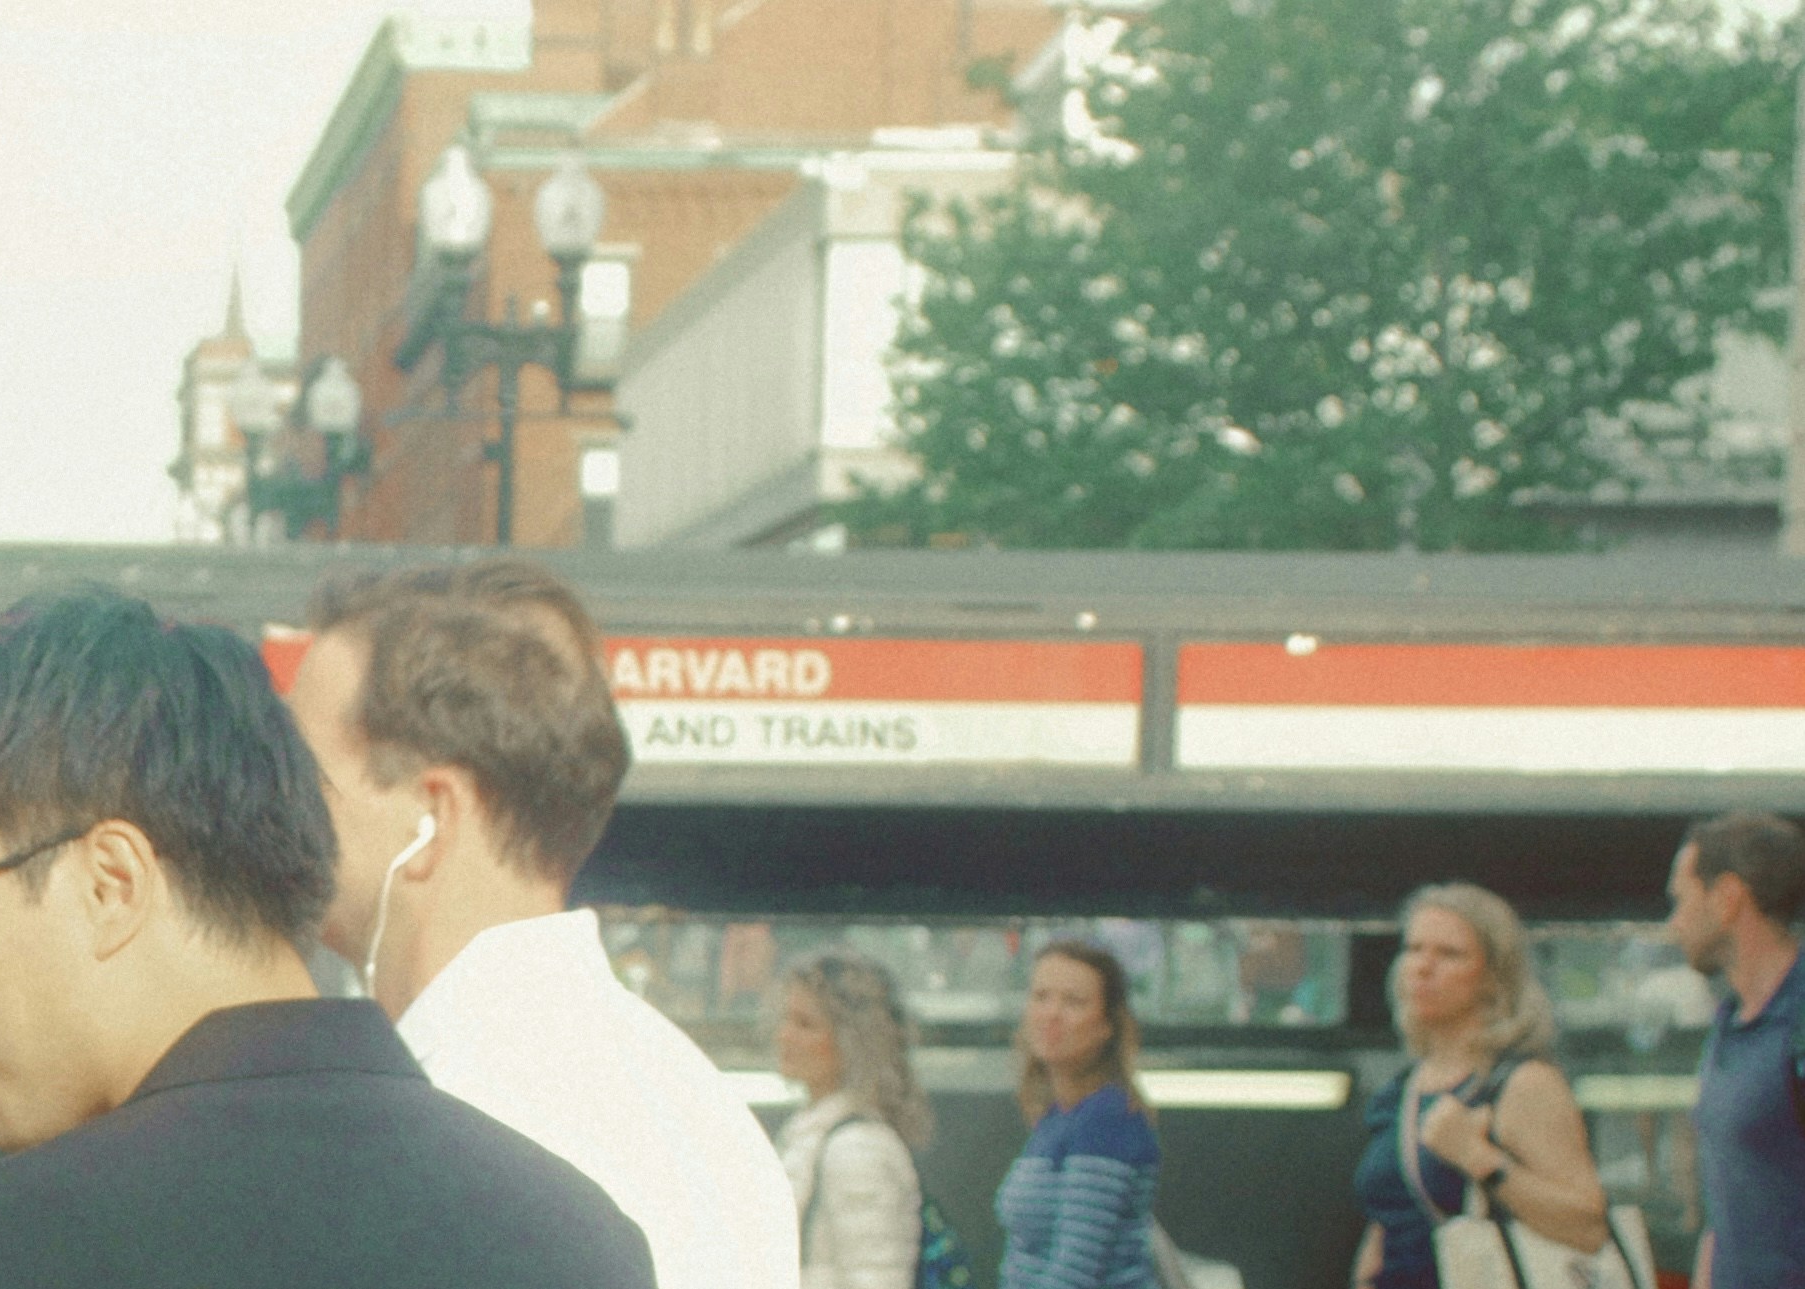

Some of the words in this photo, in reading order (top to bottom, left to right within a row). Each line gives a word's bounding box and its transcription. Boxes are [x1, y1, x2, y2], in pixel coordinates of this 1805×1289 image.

[611, 648, 832, 696] ARVARD
[645, 714, 737, 747] AND
[758, 715, 918, 751] TRAINS
